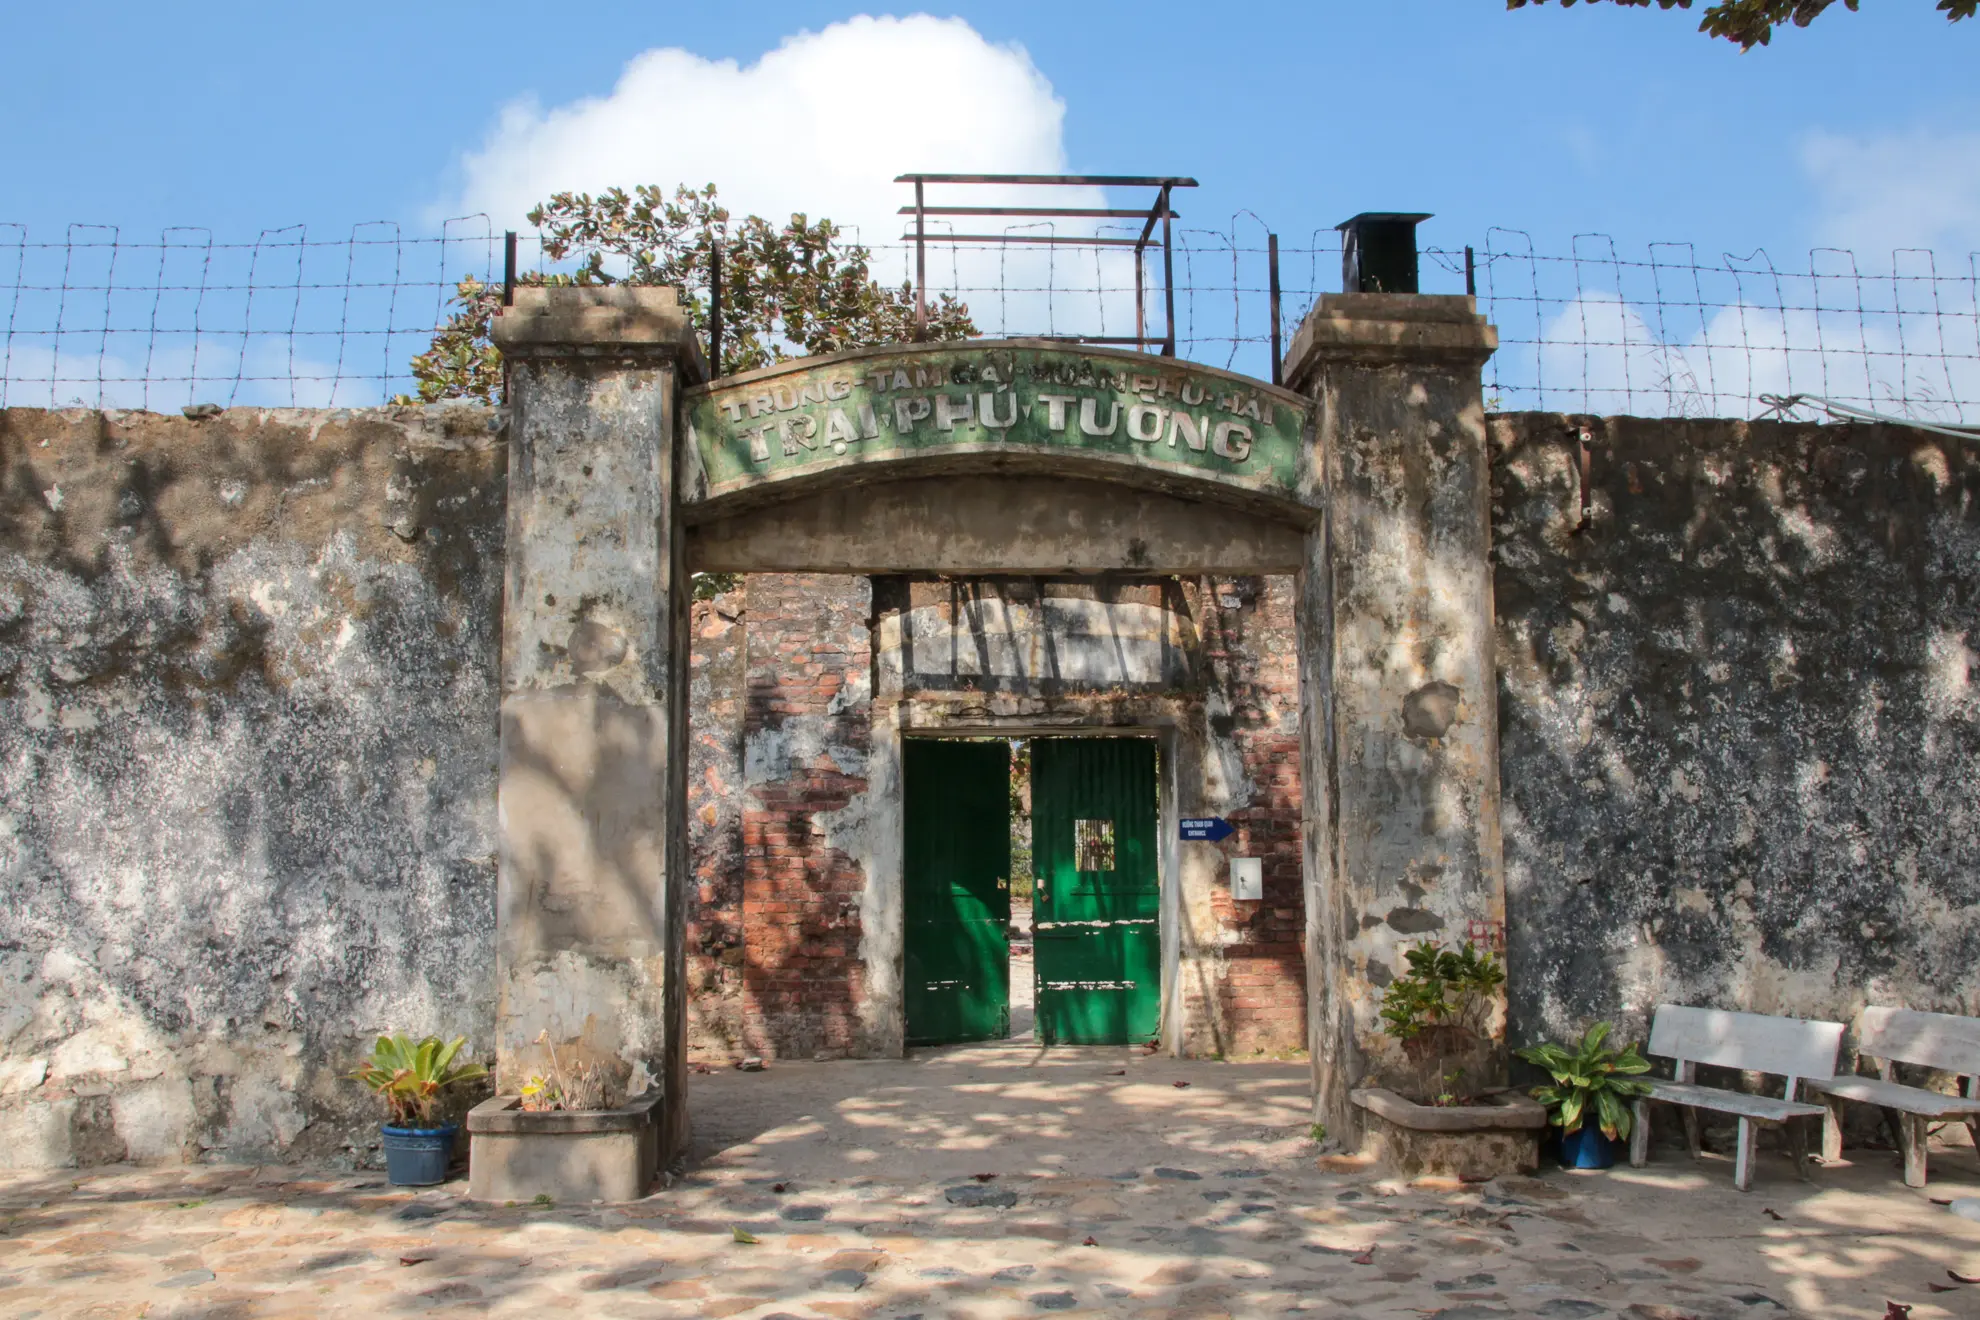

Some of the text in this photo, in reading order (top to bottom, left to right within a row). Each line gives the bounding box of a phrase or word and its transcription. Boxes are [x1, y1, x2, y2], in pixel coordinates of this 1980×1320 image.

[737, 383, 1253, 463] TRẠI PHÚ TƯỜNG
